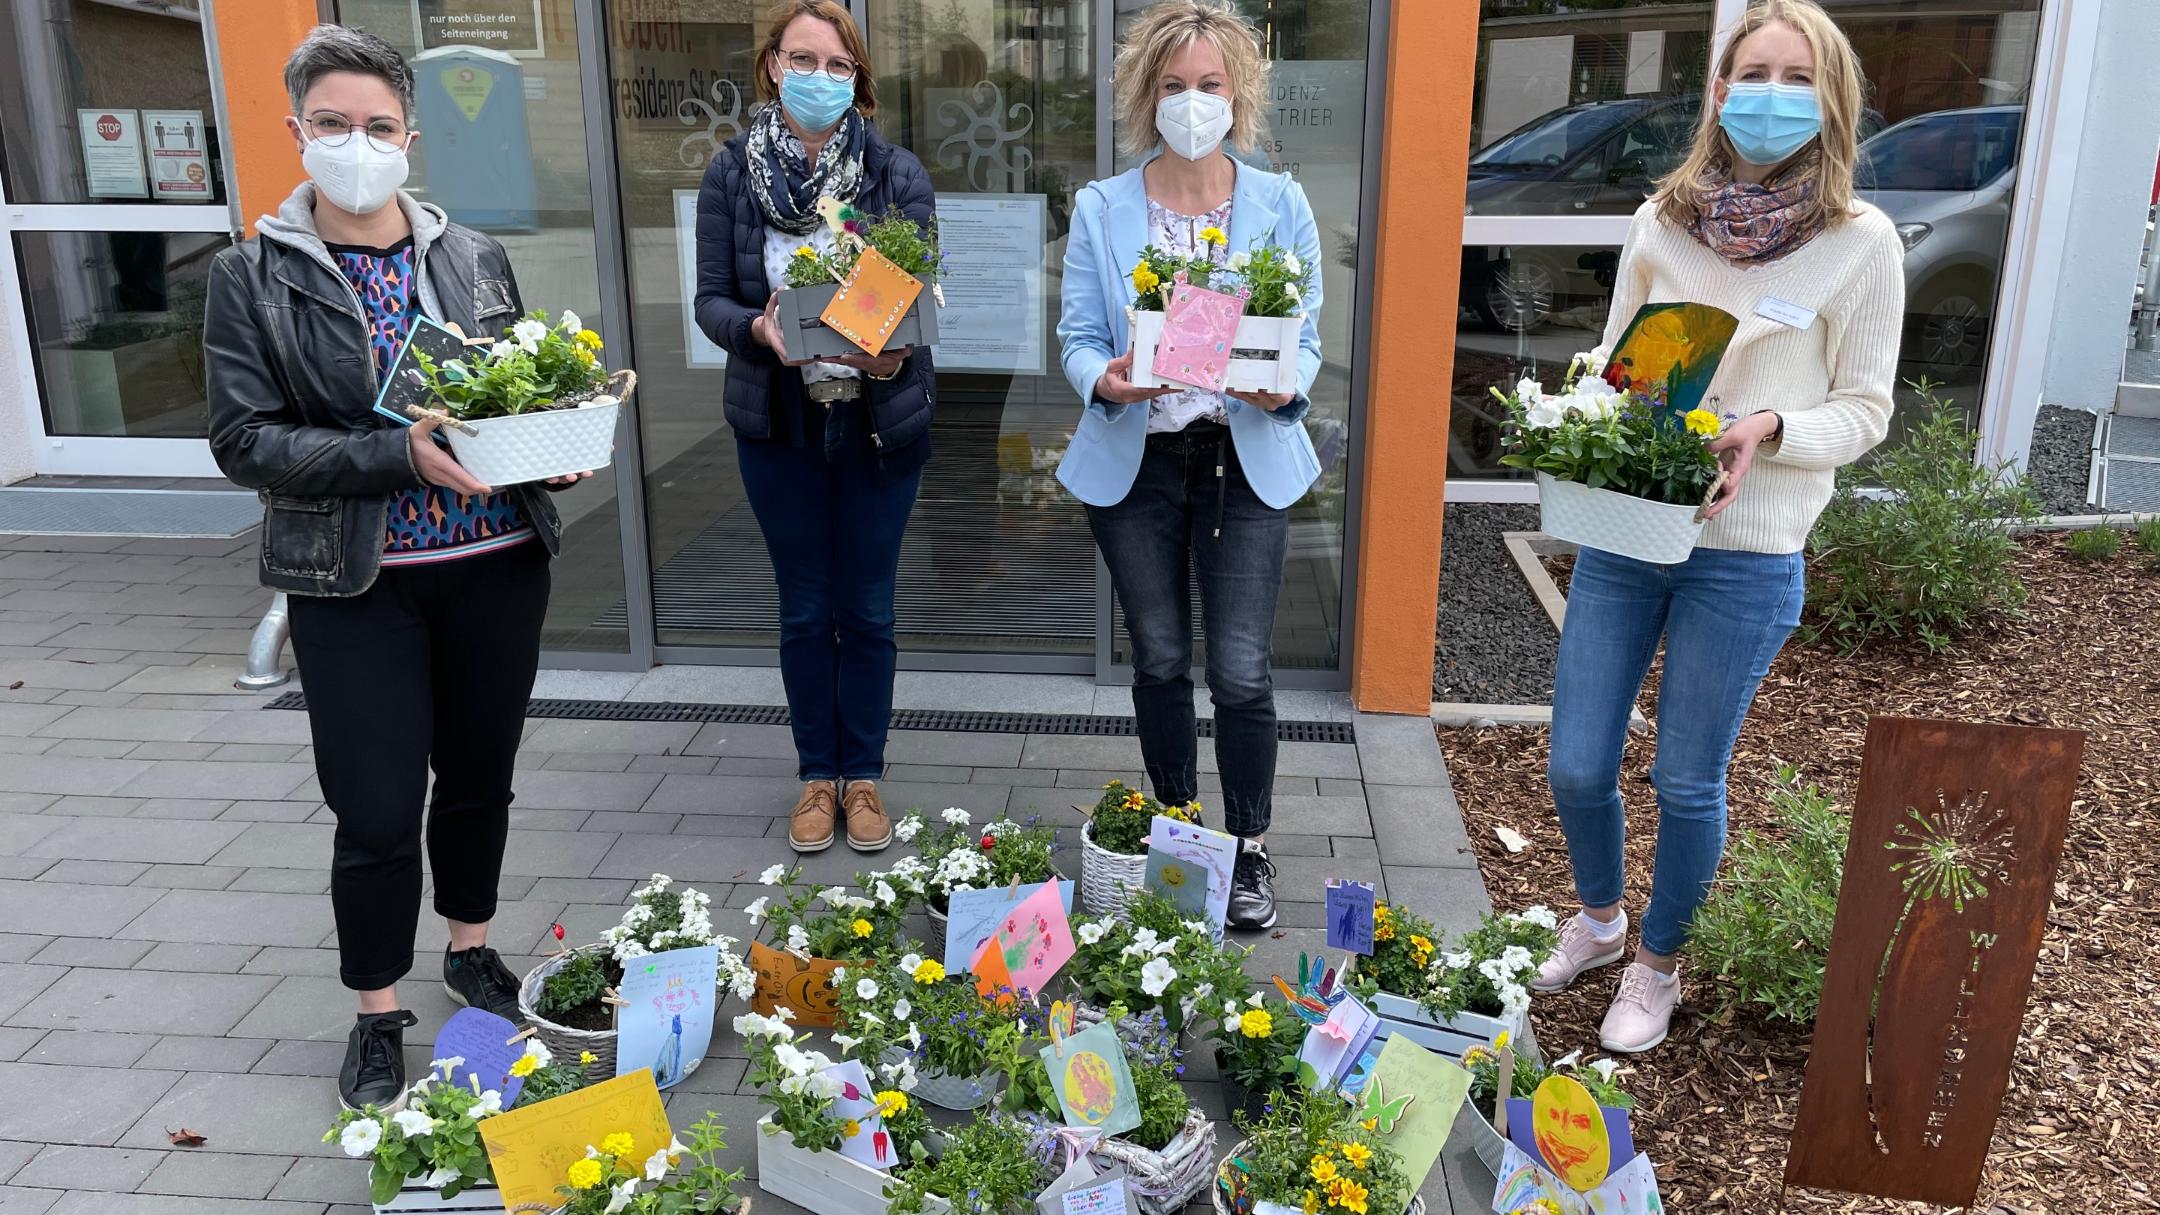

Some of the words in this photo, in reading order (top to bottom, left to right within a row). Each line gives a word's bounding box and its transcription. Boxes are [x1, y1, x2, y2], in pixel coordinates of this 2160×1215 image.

[429, 15, 446, 24] nur
[448, 13, 472, 24] noch
[474, 13, 495, 23] über
[498, 13, 516, 23] den
[441, 28, 509, 40] Seiteneingang
[1271, 85, 1320, 101] IDENZ
[1277, 108, 1334, 126] TRIER
[98, 122, 121, 134] STOP
[1271, 161, 1300, 175] ang
